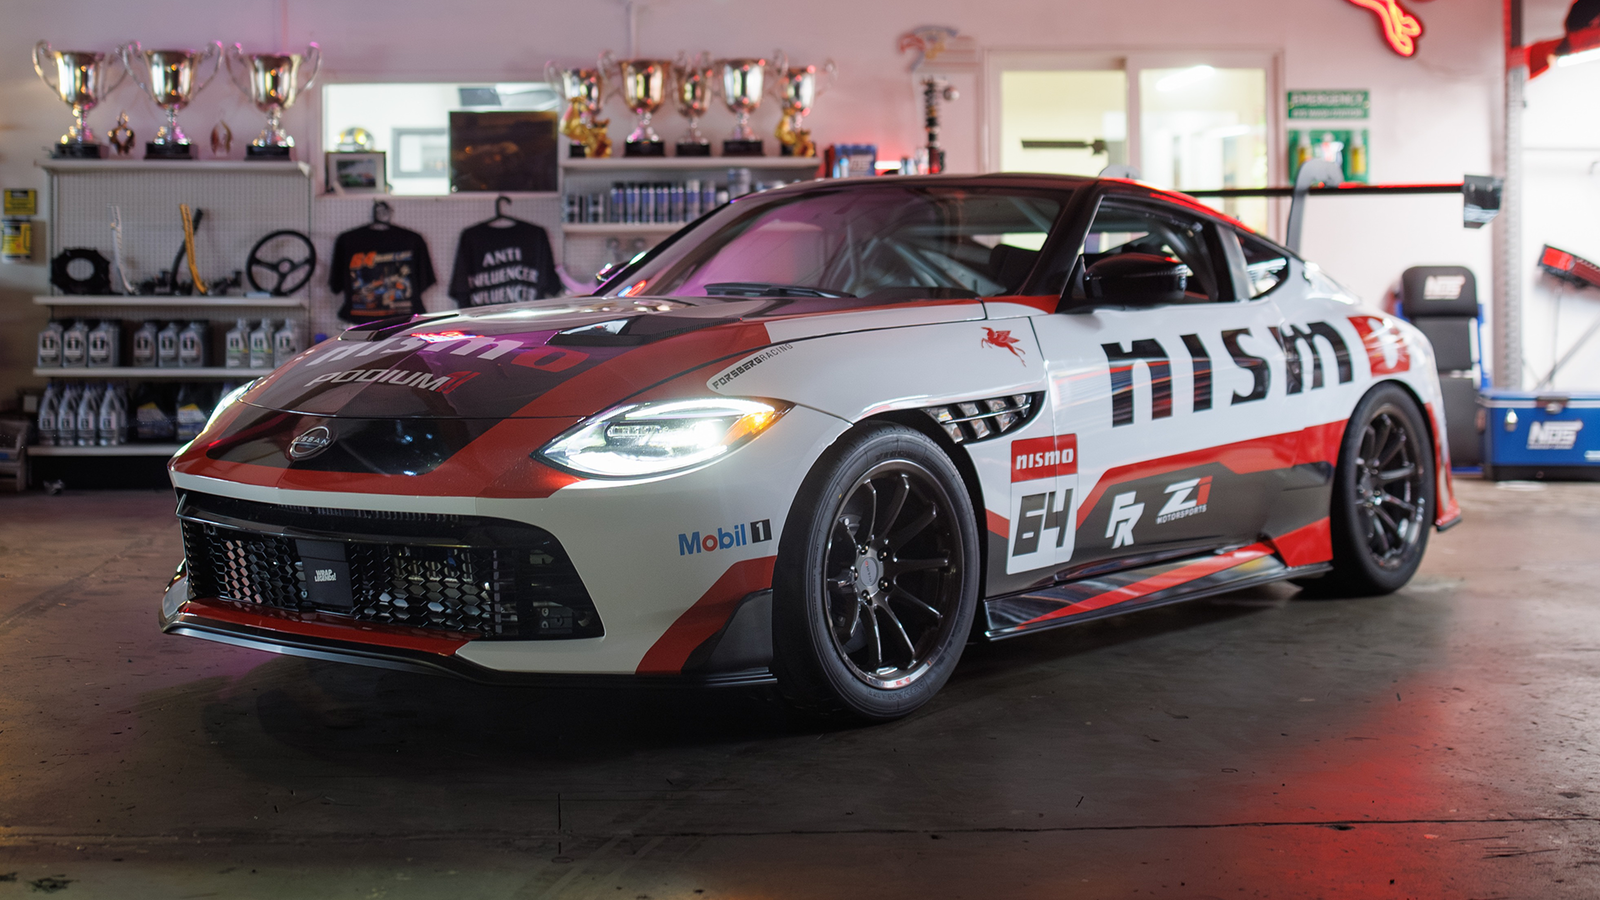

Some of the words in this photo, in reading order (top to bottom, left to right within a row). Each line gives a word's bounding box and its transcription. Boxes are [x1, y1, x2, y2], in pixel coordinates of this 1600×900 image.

[482, 247, 521, 268] ANTI
[291, 436, 331, 446] NISSAN
[1012, 488, 1073, 557] 64
[1155, 504, 1207, 525] MOTORSPORTS
[678, 523, 747, 556] Mobil
